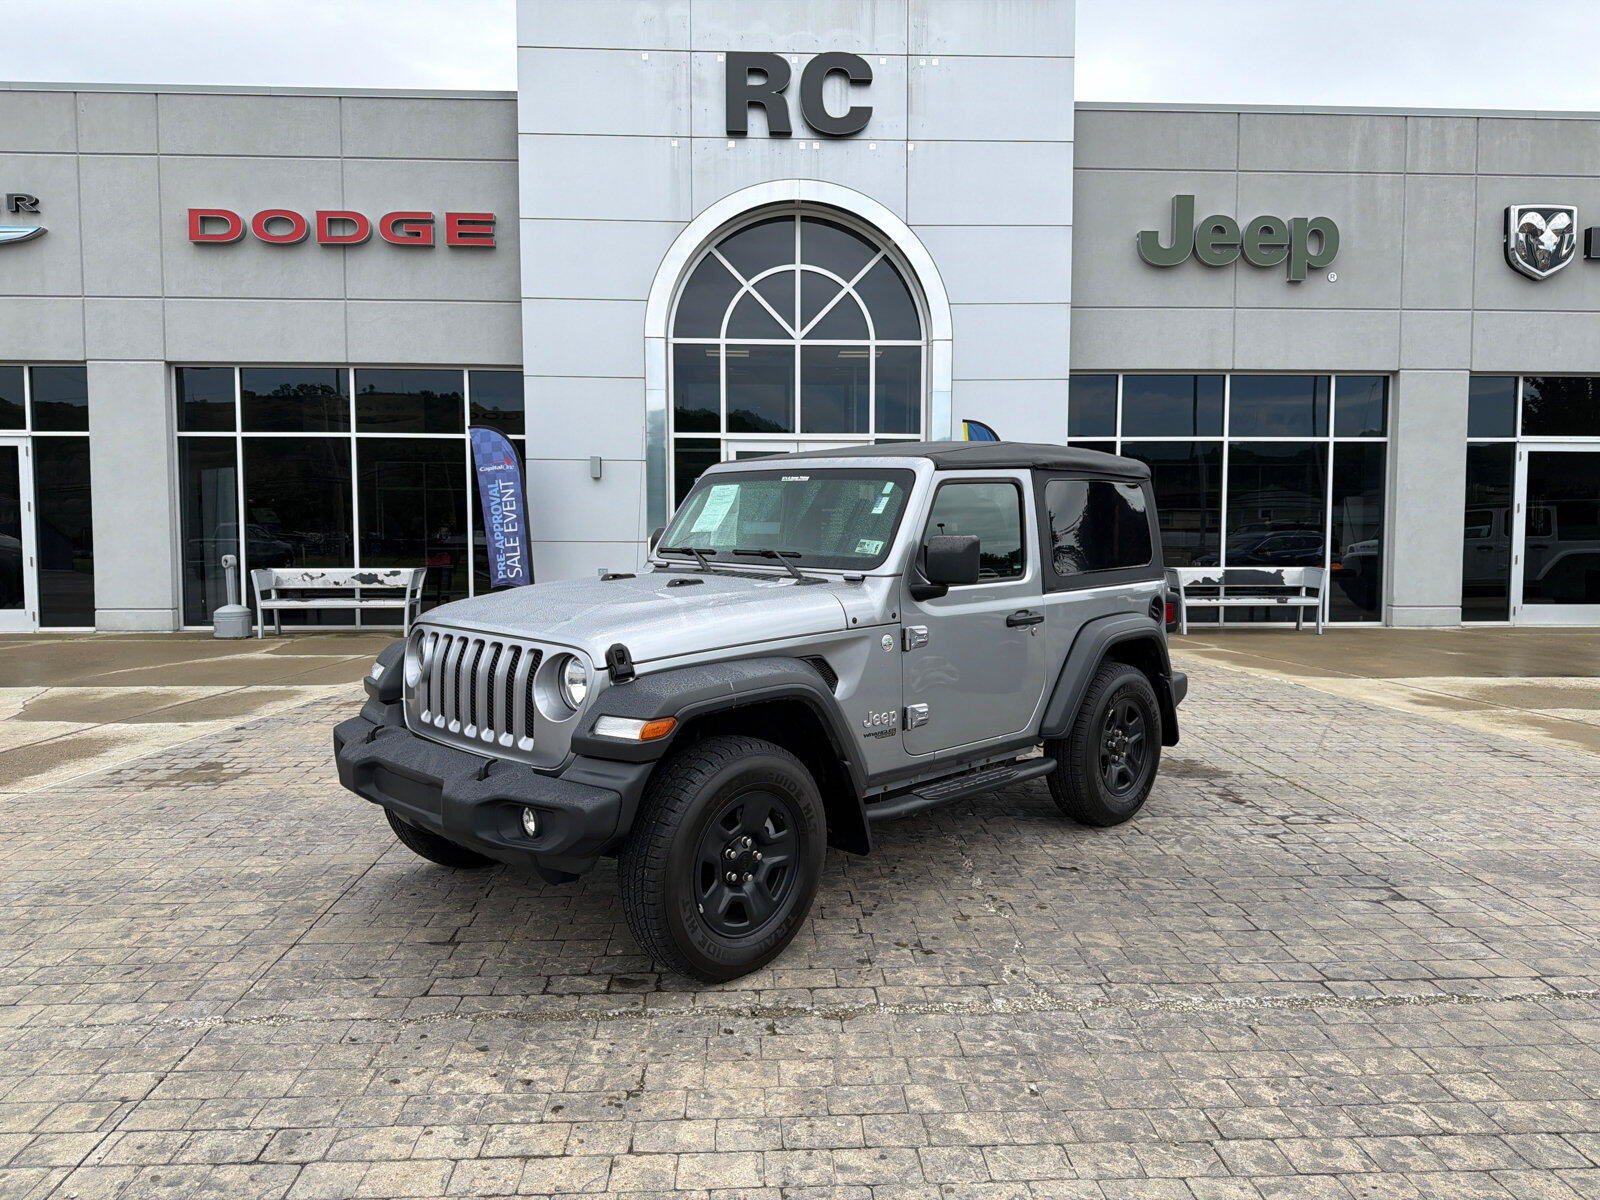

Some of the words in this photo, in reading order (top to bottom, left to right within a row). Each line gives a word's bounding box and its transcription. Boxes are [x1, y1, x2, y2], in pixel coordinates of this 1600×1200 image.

[726, 51, 874, 138] RC
[188, 208, 497, 249] DODGE
[1137, 194, 1340, 283] Jeep
[488, 479, 507, 579] PRE-APPROVAL
[499, 479, 518, 532] EVENT
[504, 536, 522, 578] SALE
[863, 710, 896, 727] Jeep
